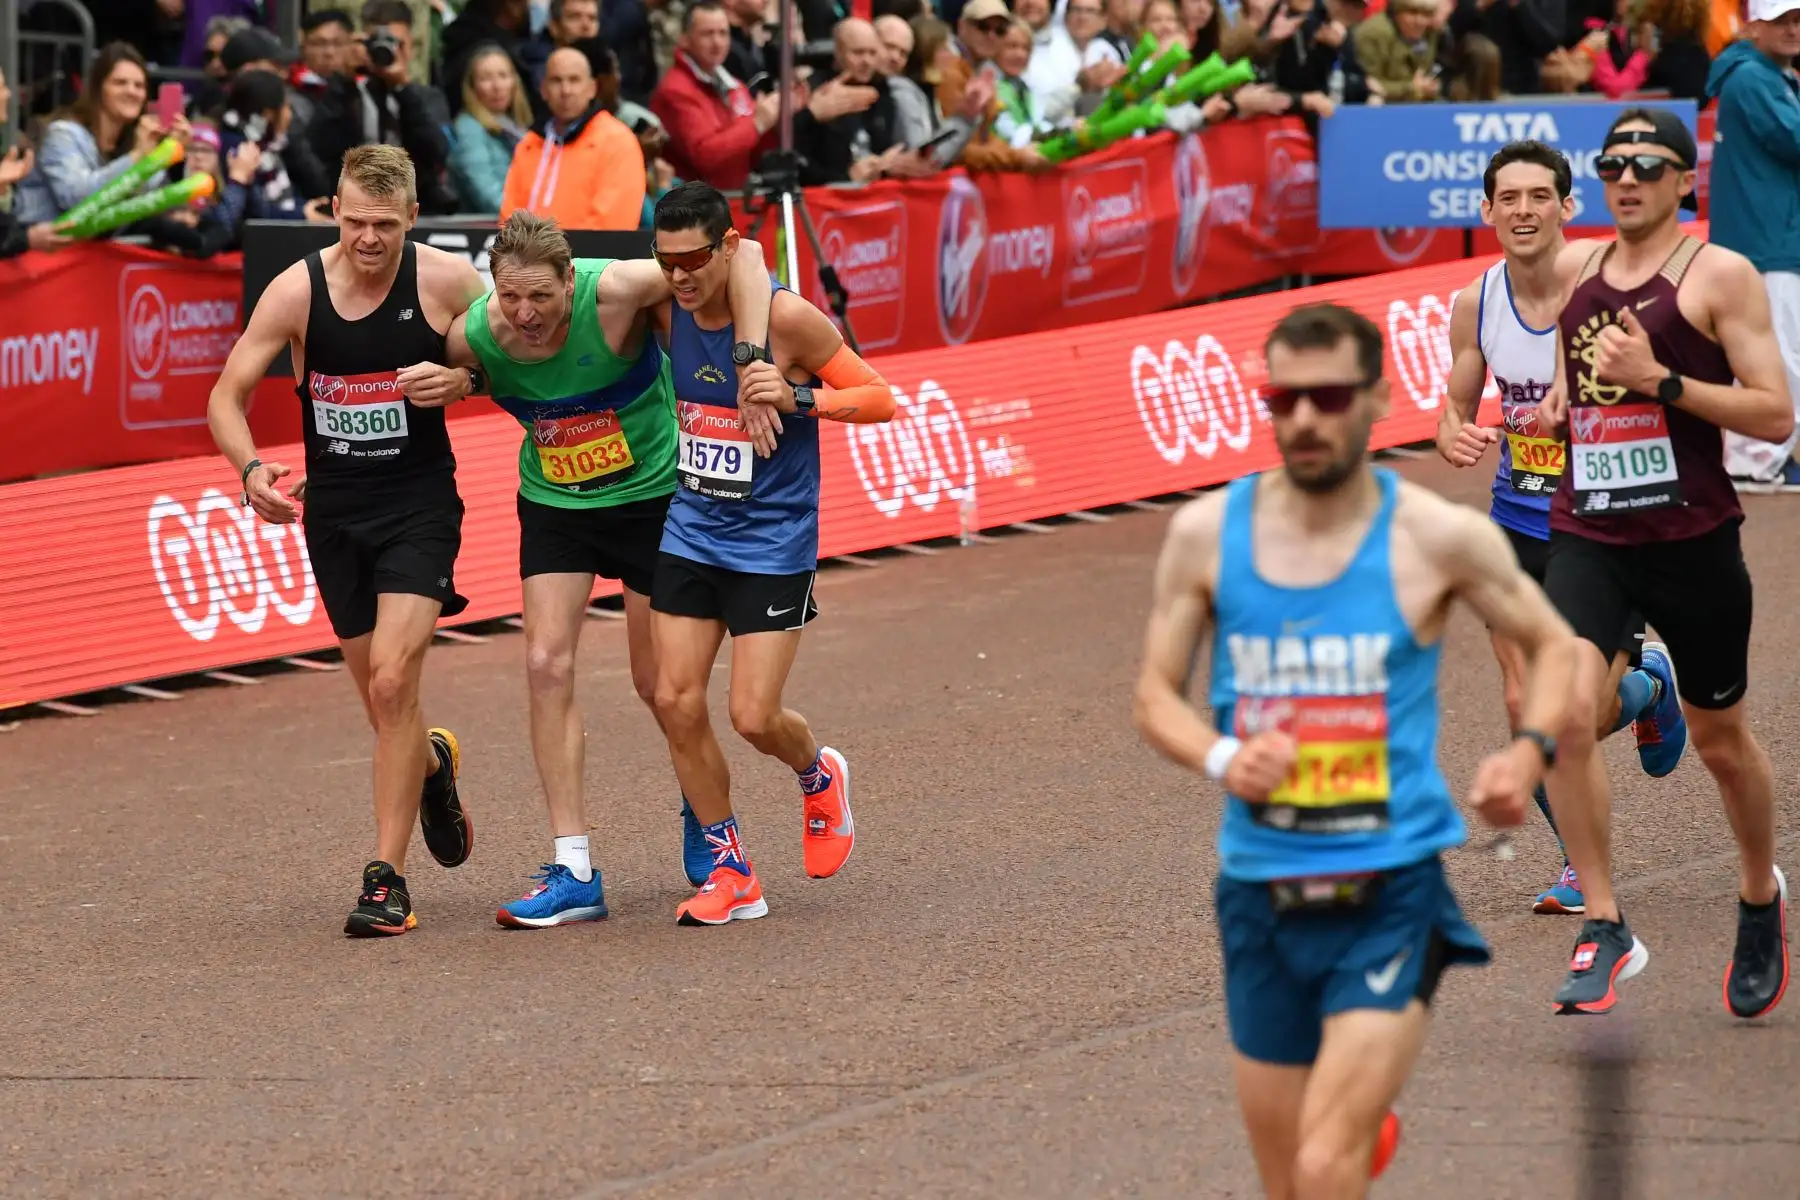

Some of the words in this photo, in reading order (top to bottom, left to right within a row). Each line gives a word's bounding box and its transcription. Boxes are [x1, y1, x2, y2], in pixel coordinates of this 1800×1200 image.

[1454, 112, 1560, 143] TATA
[989, 225, 1054, 280] money
[169, 301, 237, 331] LONDON
[1, 326, 99, 396] money
[694, 364, 727, 383] RANELAGH
[315, 375, 343, 401] Virgin
[350, 380, 398, 393] money
[326, 407, 400, 435] 58360
[534, 420, 561, 446] Virgin
[566, 416, 612, 437] money
[680, 402, 702, 432] Virgin
[706, 416, 747, 433] mone
[1505, 406, 1536, 435] Virgin
[1607, 413, 1660, 430] money
[368, 448, 400, 457] balance
[548, 440, 628, 478] 31033
[686, 439, 741, 475] 1579
[1586, 446, 1668, 481] 58109
[700, 487, 712, 495] new
[713, 489, 742, 498] balance
[1630, 494, 1670, 506] balance
[1227, 634, 1391, 695] MARK
